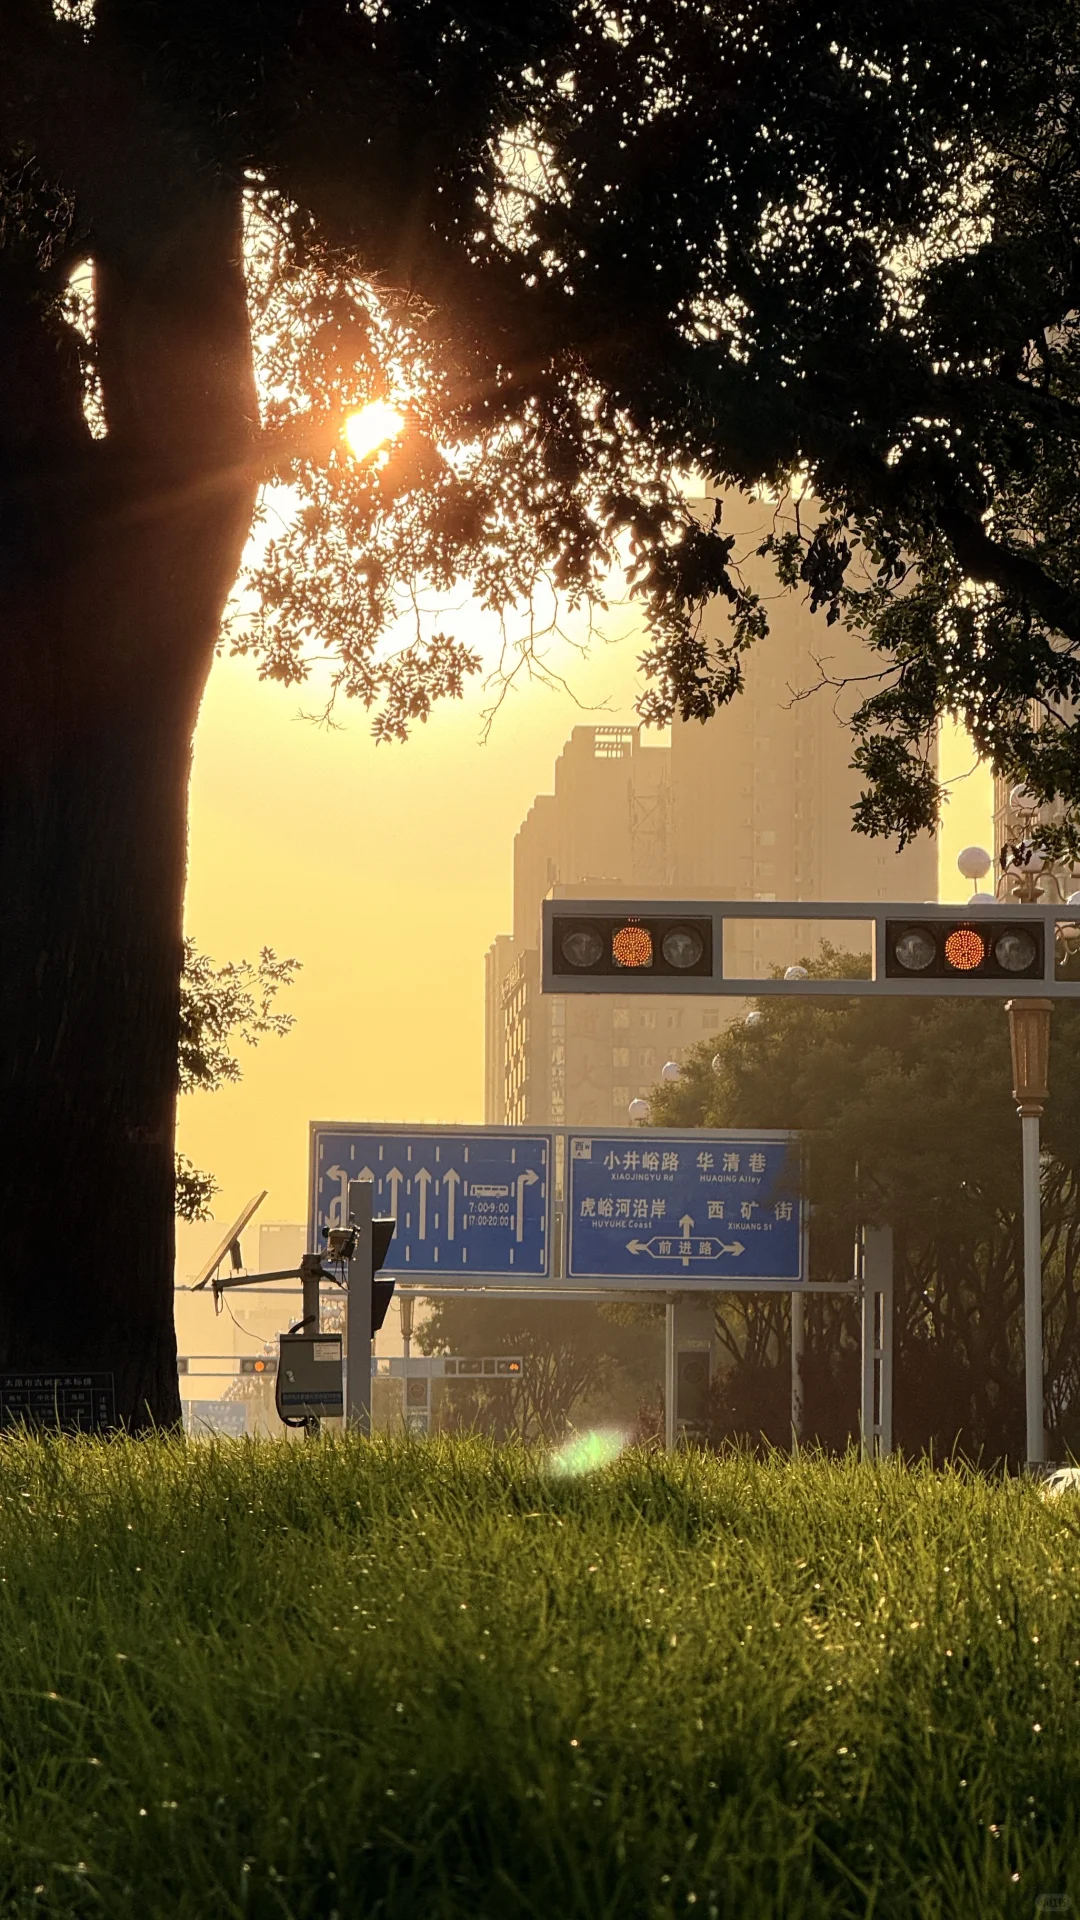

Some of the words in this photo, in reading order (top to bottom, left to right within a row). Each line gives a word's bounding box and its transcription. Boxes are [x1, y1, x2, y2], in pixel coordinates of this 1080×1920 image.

[604, 1151, 679, 1171] 小井峪路
[696, 1152, 766, 1172] 华清巷
[611, 1173, 661, 1181] XIAOJINGYU
[739, 1176, 761, 1184] Alley
[469, 1202, 510, 1212] 7:00-9:00
[580, 1199, 665, 1217] 虎峪河沿岸
[707, 1201, 793, 1221] 西矿街
[469, 1215, 509, 1226] 17:00-20:00
[628, 1221, 652, 1229] Coast
[658, 1241, 712, 1256] 前进路
